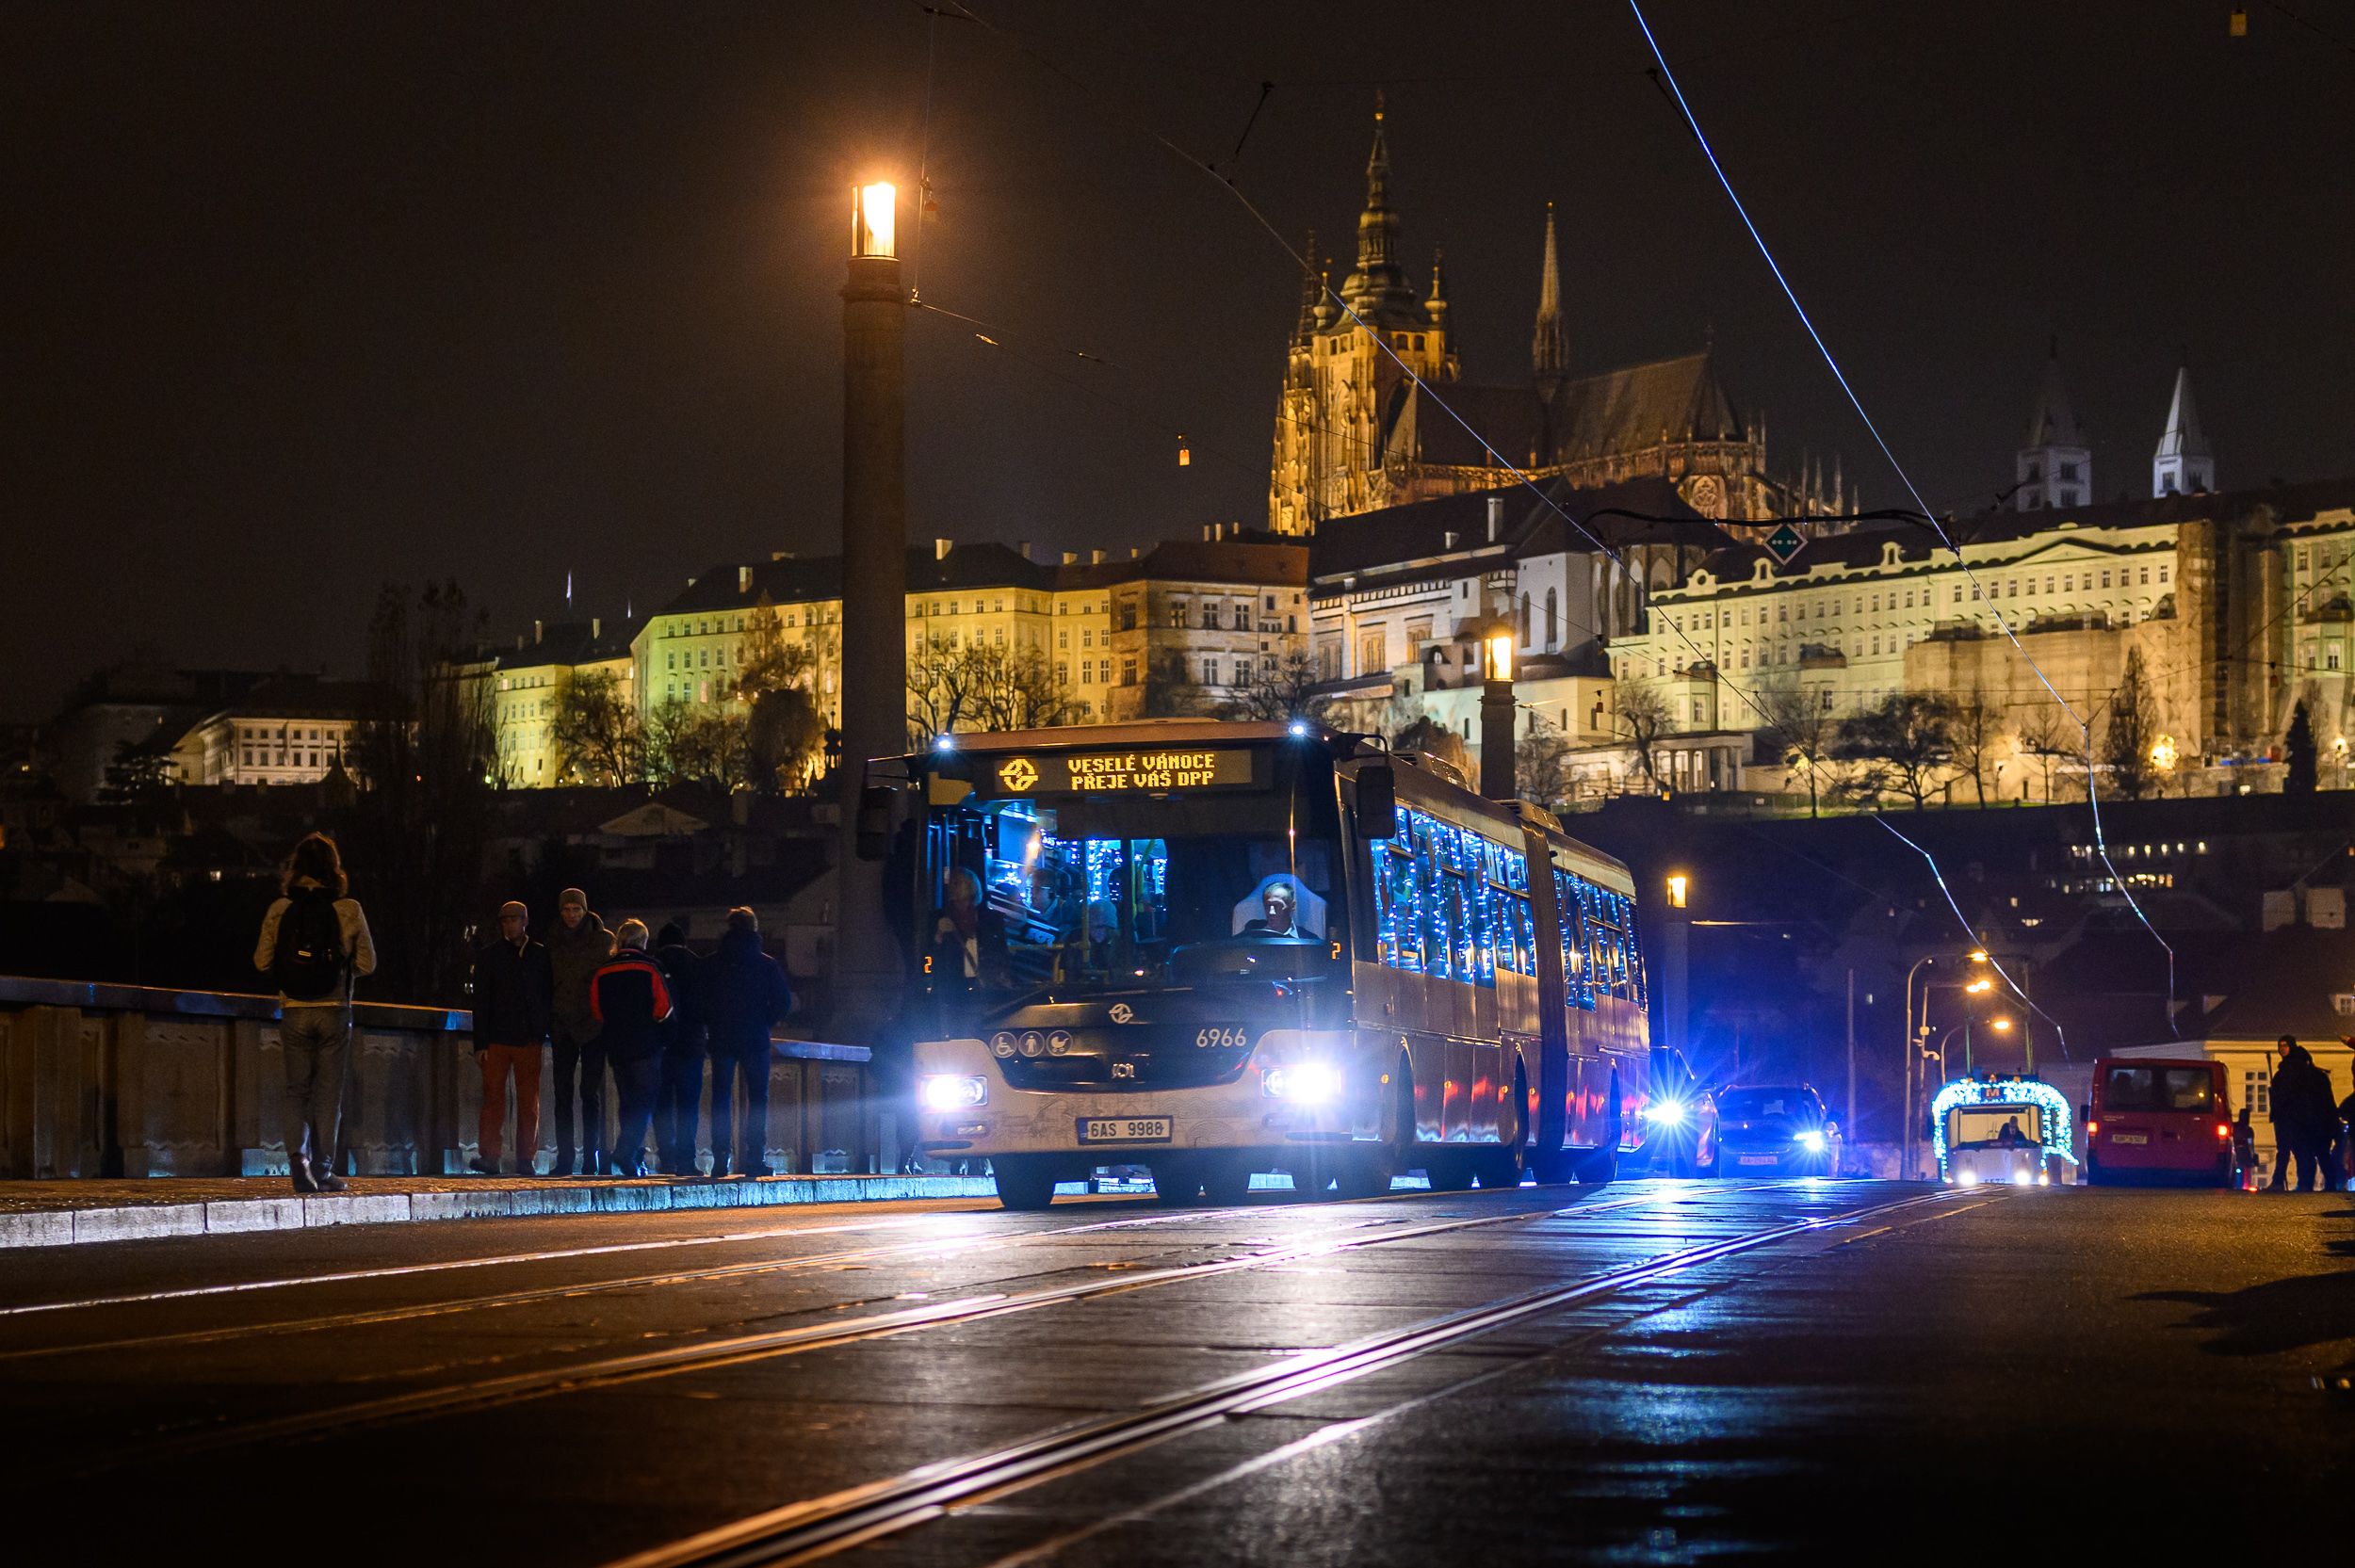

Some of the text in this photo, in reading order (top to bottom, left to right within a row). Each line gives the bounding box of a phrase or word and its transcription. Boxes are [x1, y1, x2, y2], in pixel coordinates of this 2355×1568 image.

[1067, 752, 1215, 773] VESELÉ VÁNOCE
[1071, 769, 1214, 790] PŘEJE VÁŠ DPP
[1196, 1027, 1246, 1048] 6966
[1090, 1123, 1117, 1138] 6AS
